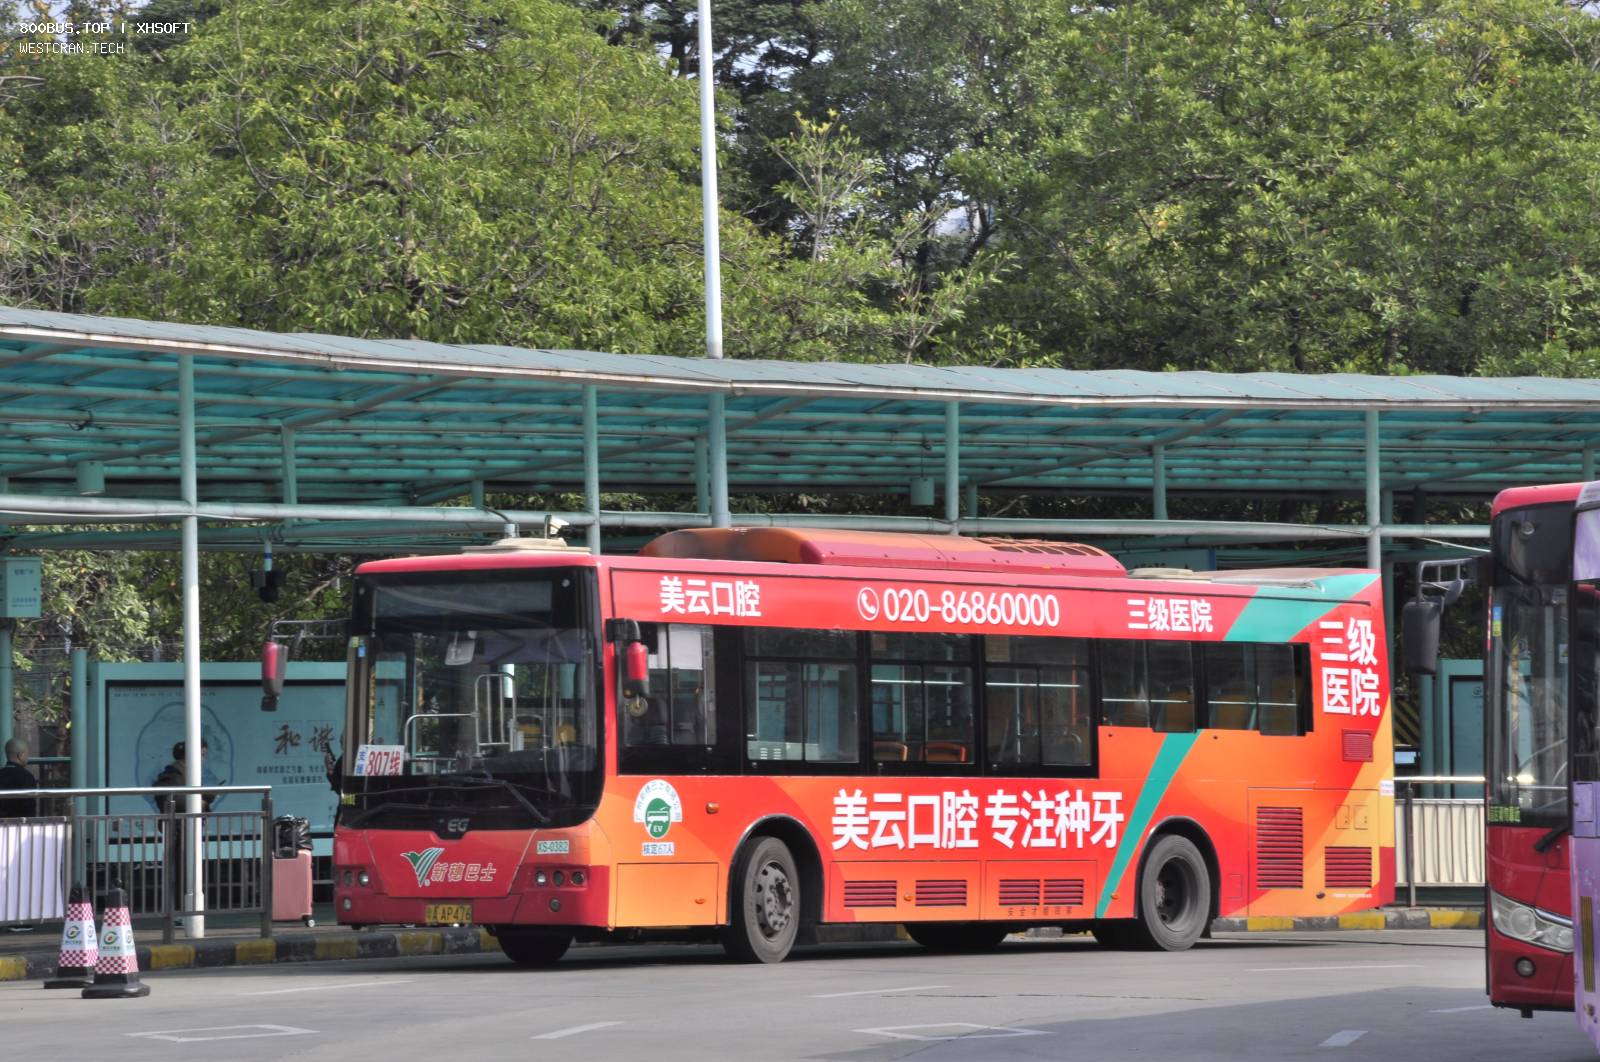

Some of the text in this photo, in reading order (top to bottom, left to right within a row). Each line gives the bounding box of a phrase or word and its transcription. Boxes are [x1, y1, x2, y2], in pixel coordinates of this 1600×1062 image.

[659, 576, 762, 618] 美云口腔
[883, 588, 1060, 627] 020-86860000
[1127, 597, 1213, 632] 三级医院
[1319, 617, 1378, 666] 三级
[1321, 667, 1380, 717] 医院
[653, 825, 663, 833] EV
[430, 862, 497, 882] 新穗巴士
